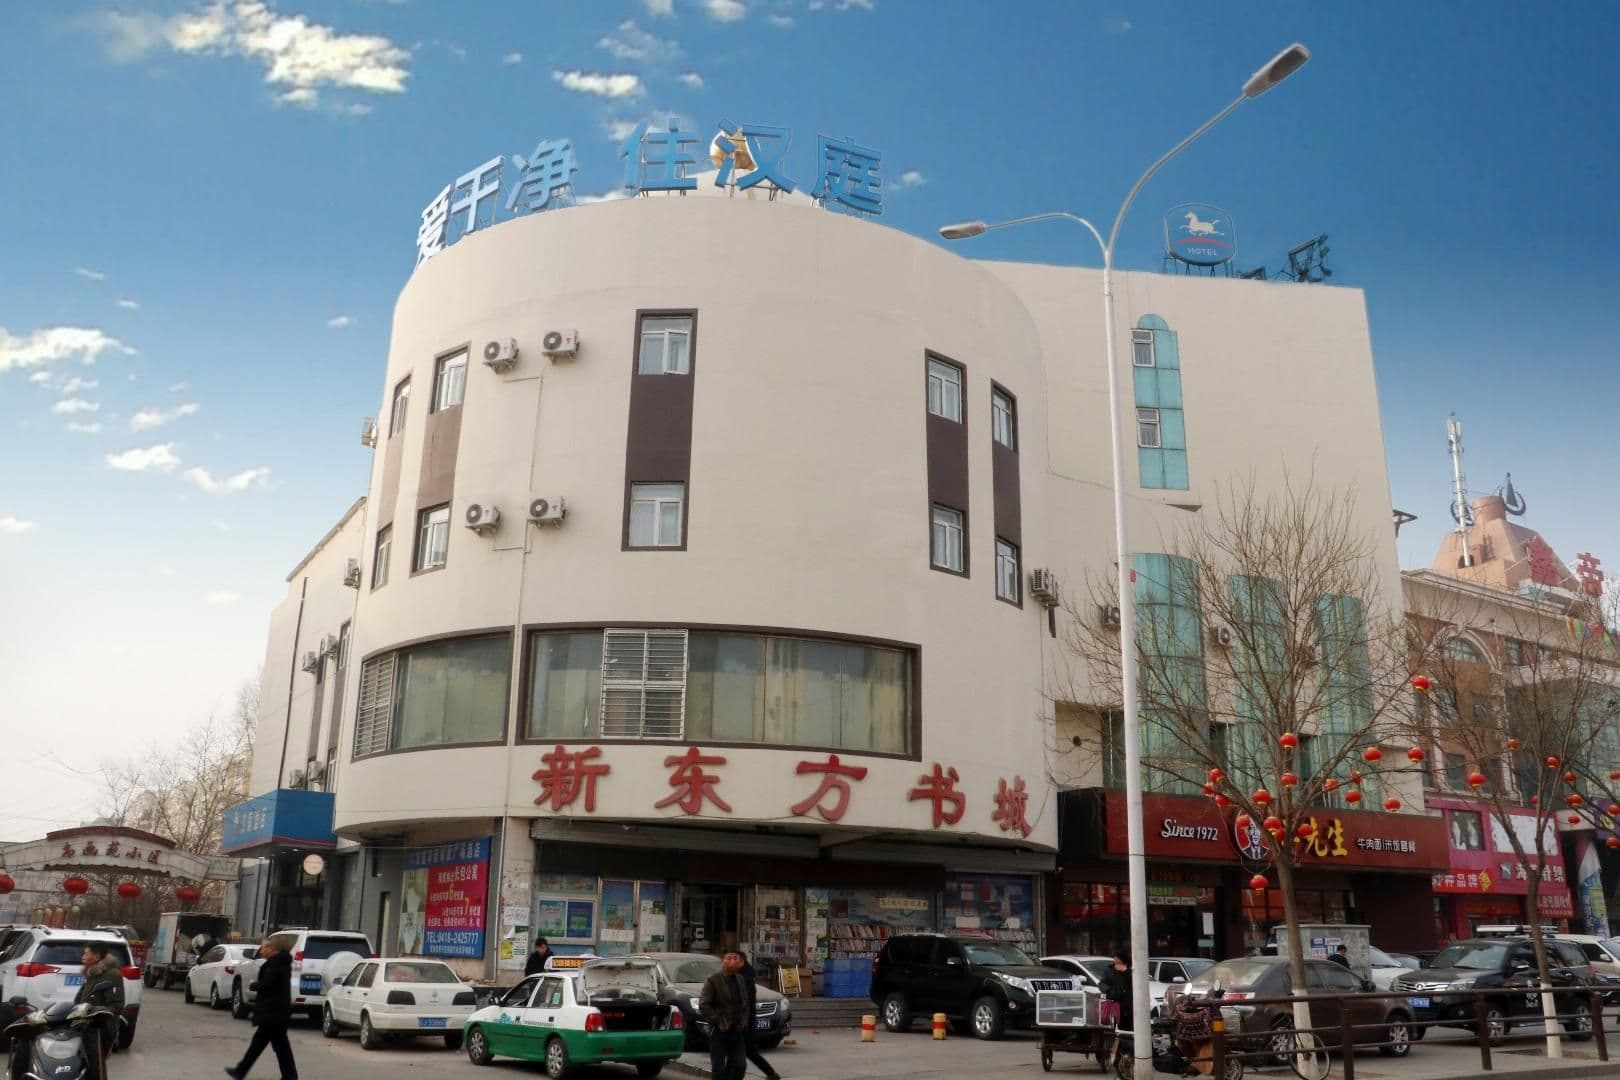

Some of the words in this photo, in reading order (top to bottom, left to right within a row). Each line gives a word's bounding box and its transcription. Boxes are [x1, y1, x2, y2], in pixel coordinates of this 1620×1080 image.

[414, 137, 579, 264] 爱干净
[616, 117, 884, 215] 住汉庭
[1187, 247, 1217, 256] HOTEL
[531, 744, 1033, 838] 新东方书城
[1161, 818, 1196, 840] Since
[1196, 826, 1219, 841] 1972
